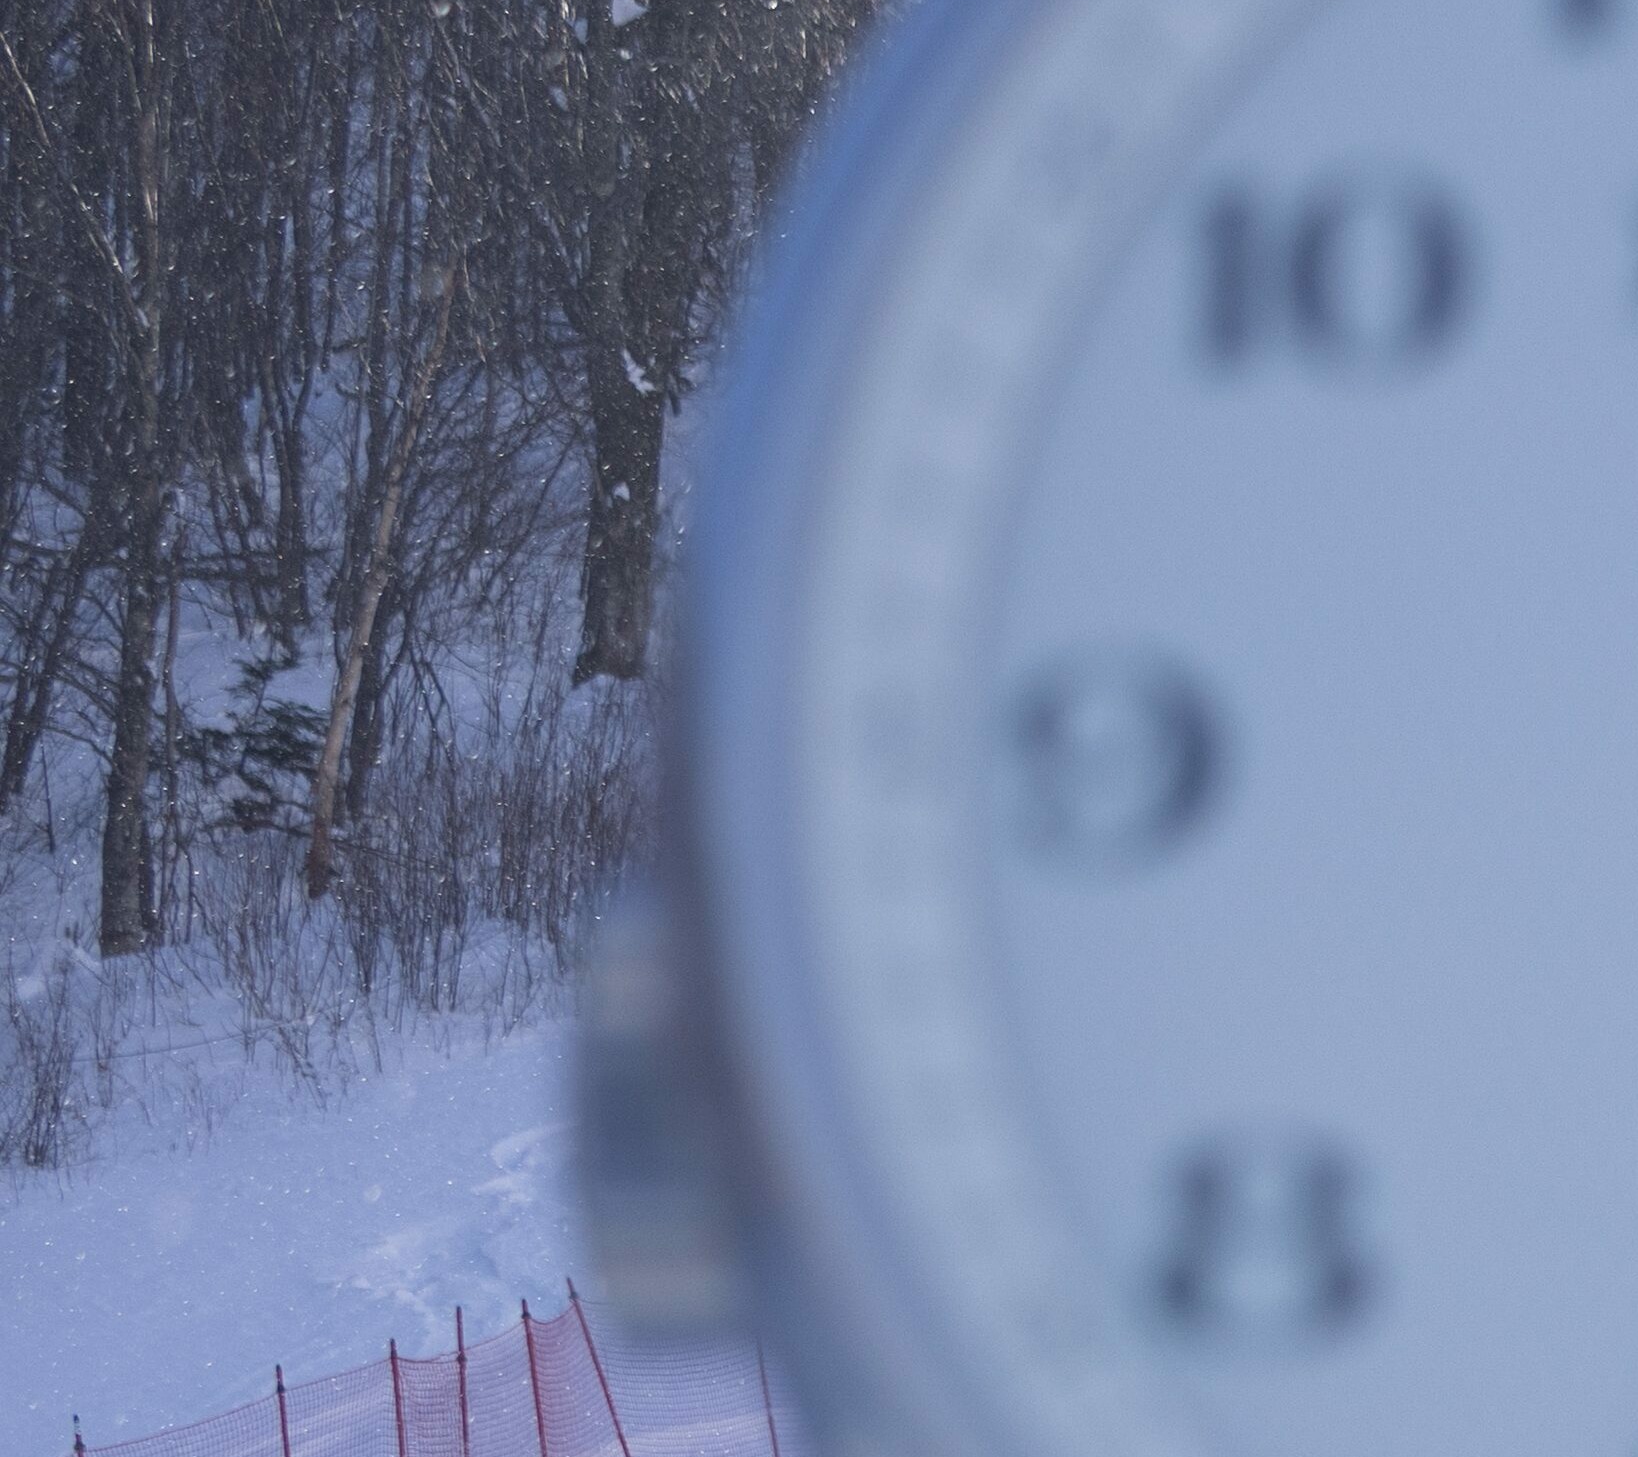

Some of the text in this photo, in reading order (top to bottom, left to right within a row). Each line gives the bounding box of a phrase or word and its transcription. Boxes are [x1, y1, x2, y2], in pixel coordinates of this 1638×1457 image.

[1186, 177, 1477, 378] 10
[1008, 650, 1228, 861] 9
[1148, 1128, 1373, 1349] 8
